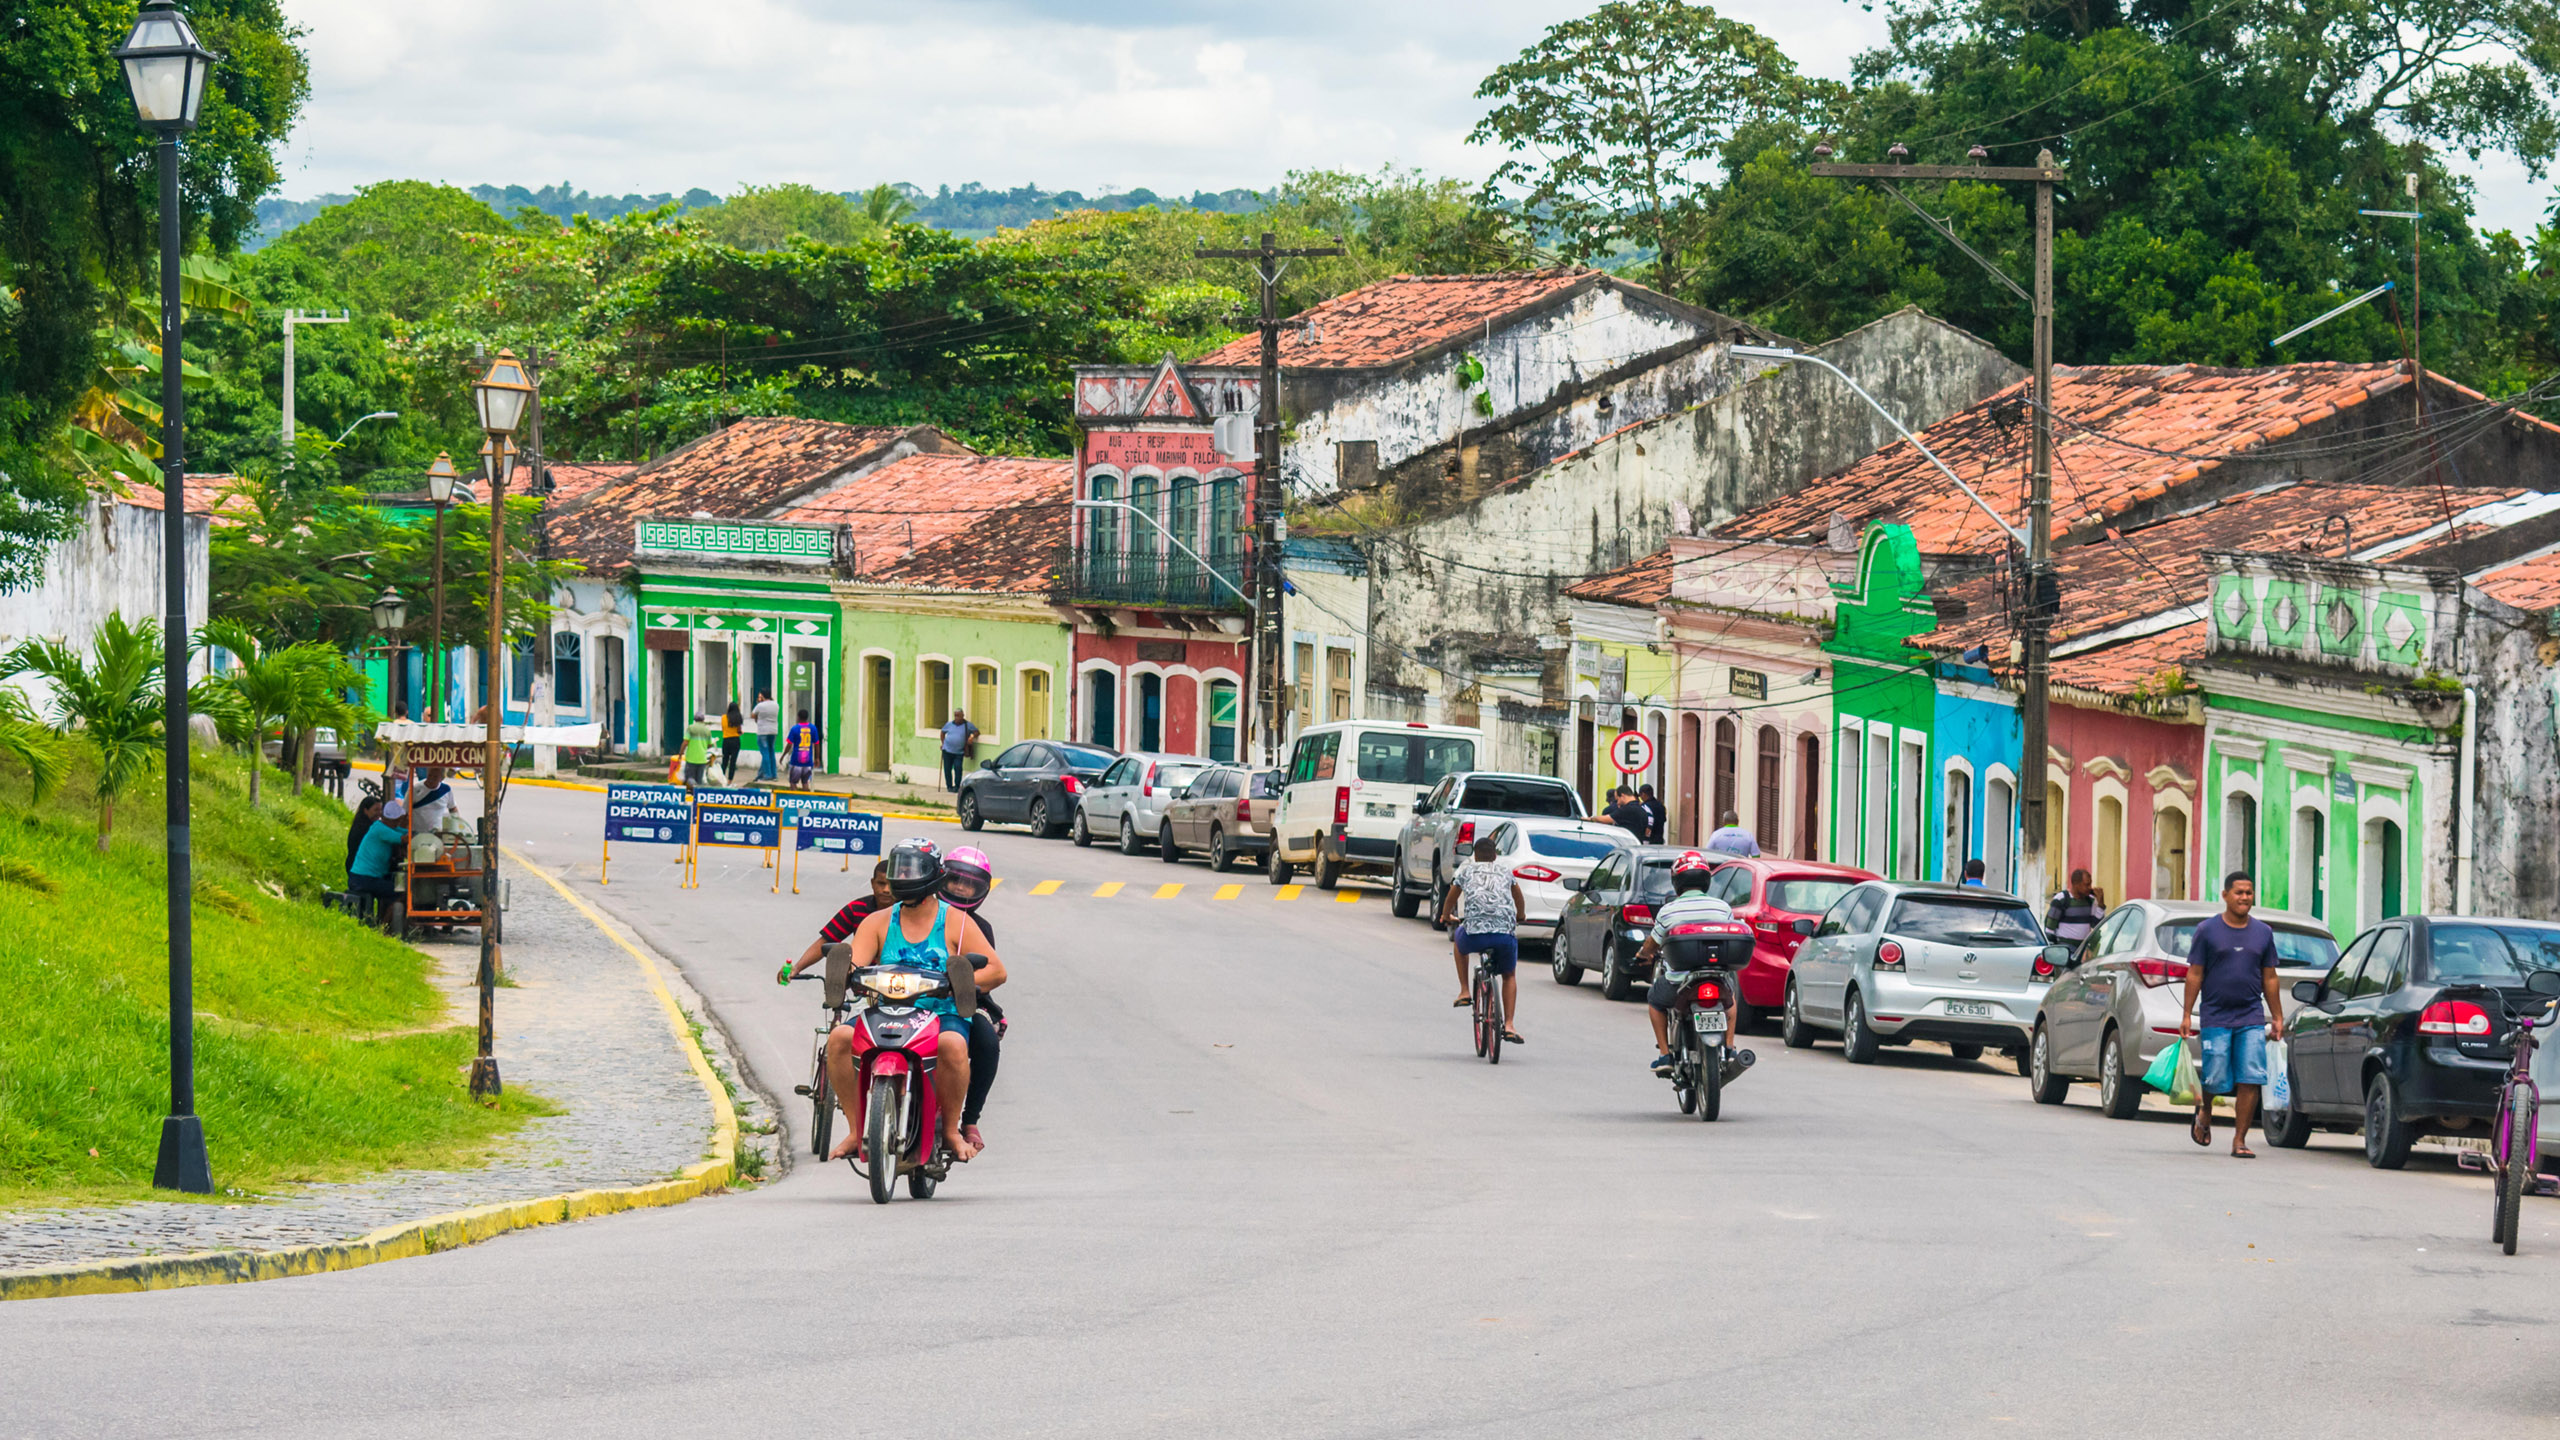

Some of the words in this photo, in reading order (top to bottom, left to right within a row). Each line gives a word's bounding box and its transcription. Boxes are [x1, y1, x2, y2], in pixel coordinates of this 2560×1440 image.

[1156, 451, 1187, 464] MARINHO
[799, 732, 811, 747] 10
[461, 747, 486, 764] CAN
[1624, 740, 1640, 765] E
[611, 789, 682, 803] DEPATRAN
[697, 793, 768, 807] DEPATRAN
[610, 805, 688, 820] DEPATRAN
[779, 799, 846, 812] DEPATRAN
[703, 812, 776, 826] DEPATRAN
[802, 816, 879, 832] DEPATRAN
[1701, 1016, 1720, 1024] PEK
